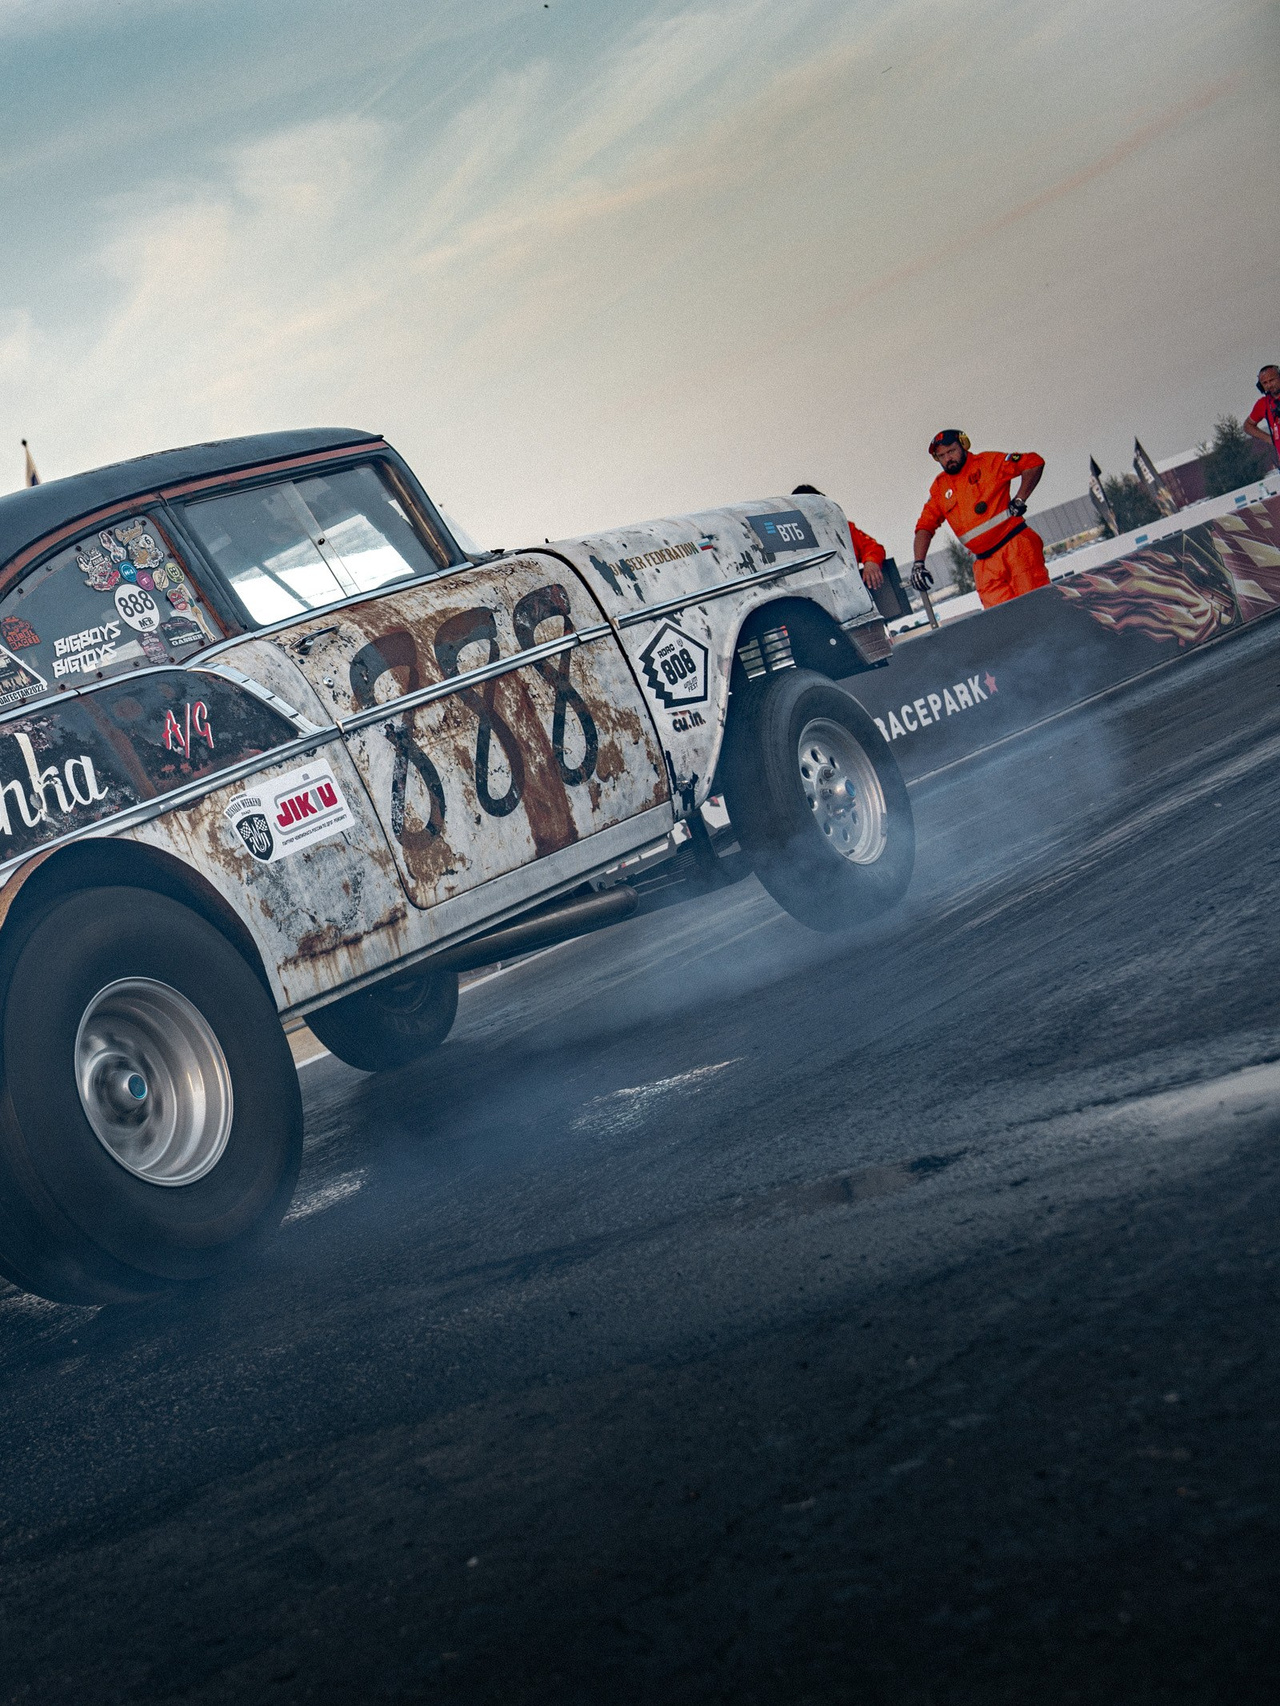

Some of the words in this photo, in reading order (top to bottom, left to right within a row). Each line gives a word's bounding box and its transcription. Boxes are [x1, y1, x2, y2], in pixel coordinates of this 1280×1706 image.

[776, 522, 805, 543] ВТБ
[646, 541, 699, 568] FEDERATION
[118, 590, 155, 618] 888
[6, 629, 36, 643] REBEL
[53, 620, 121, 658] BIGBOYS
[657, 643, 675, 659] RDRC
[52, 642, 118, 678] BIGTOYS
[660, 648, 696, 685] 808
[349, 584, 599, 846] 888
[277, 782, 338, 827] JIKIU
